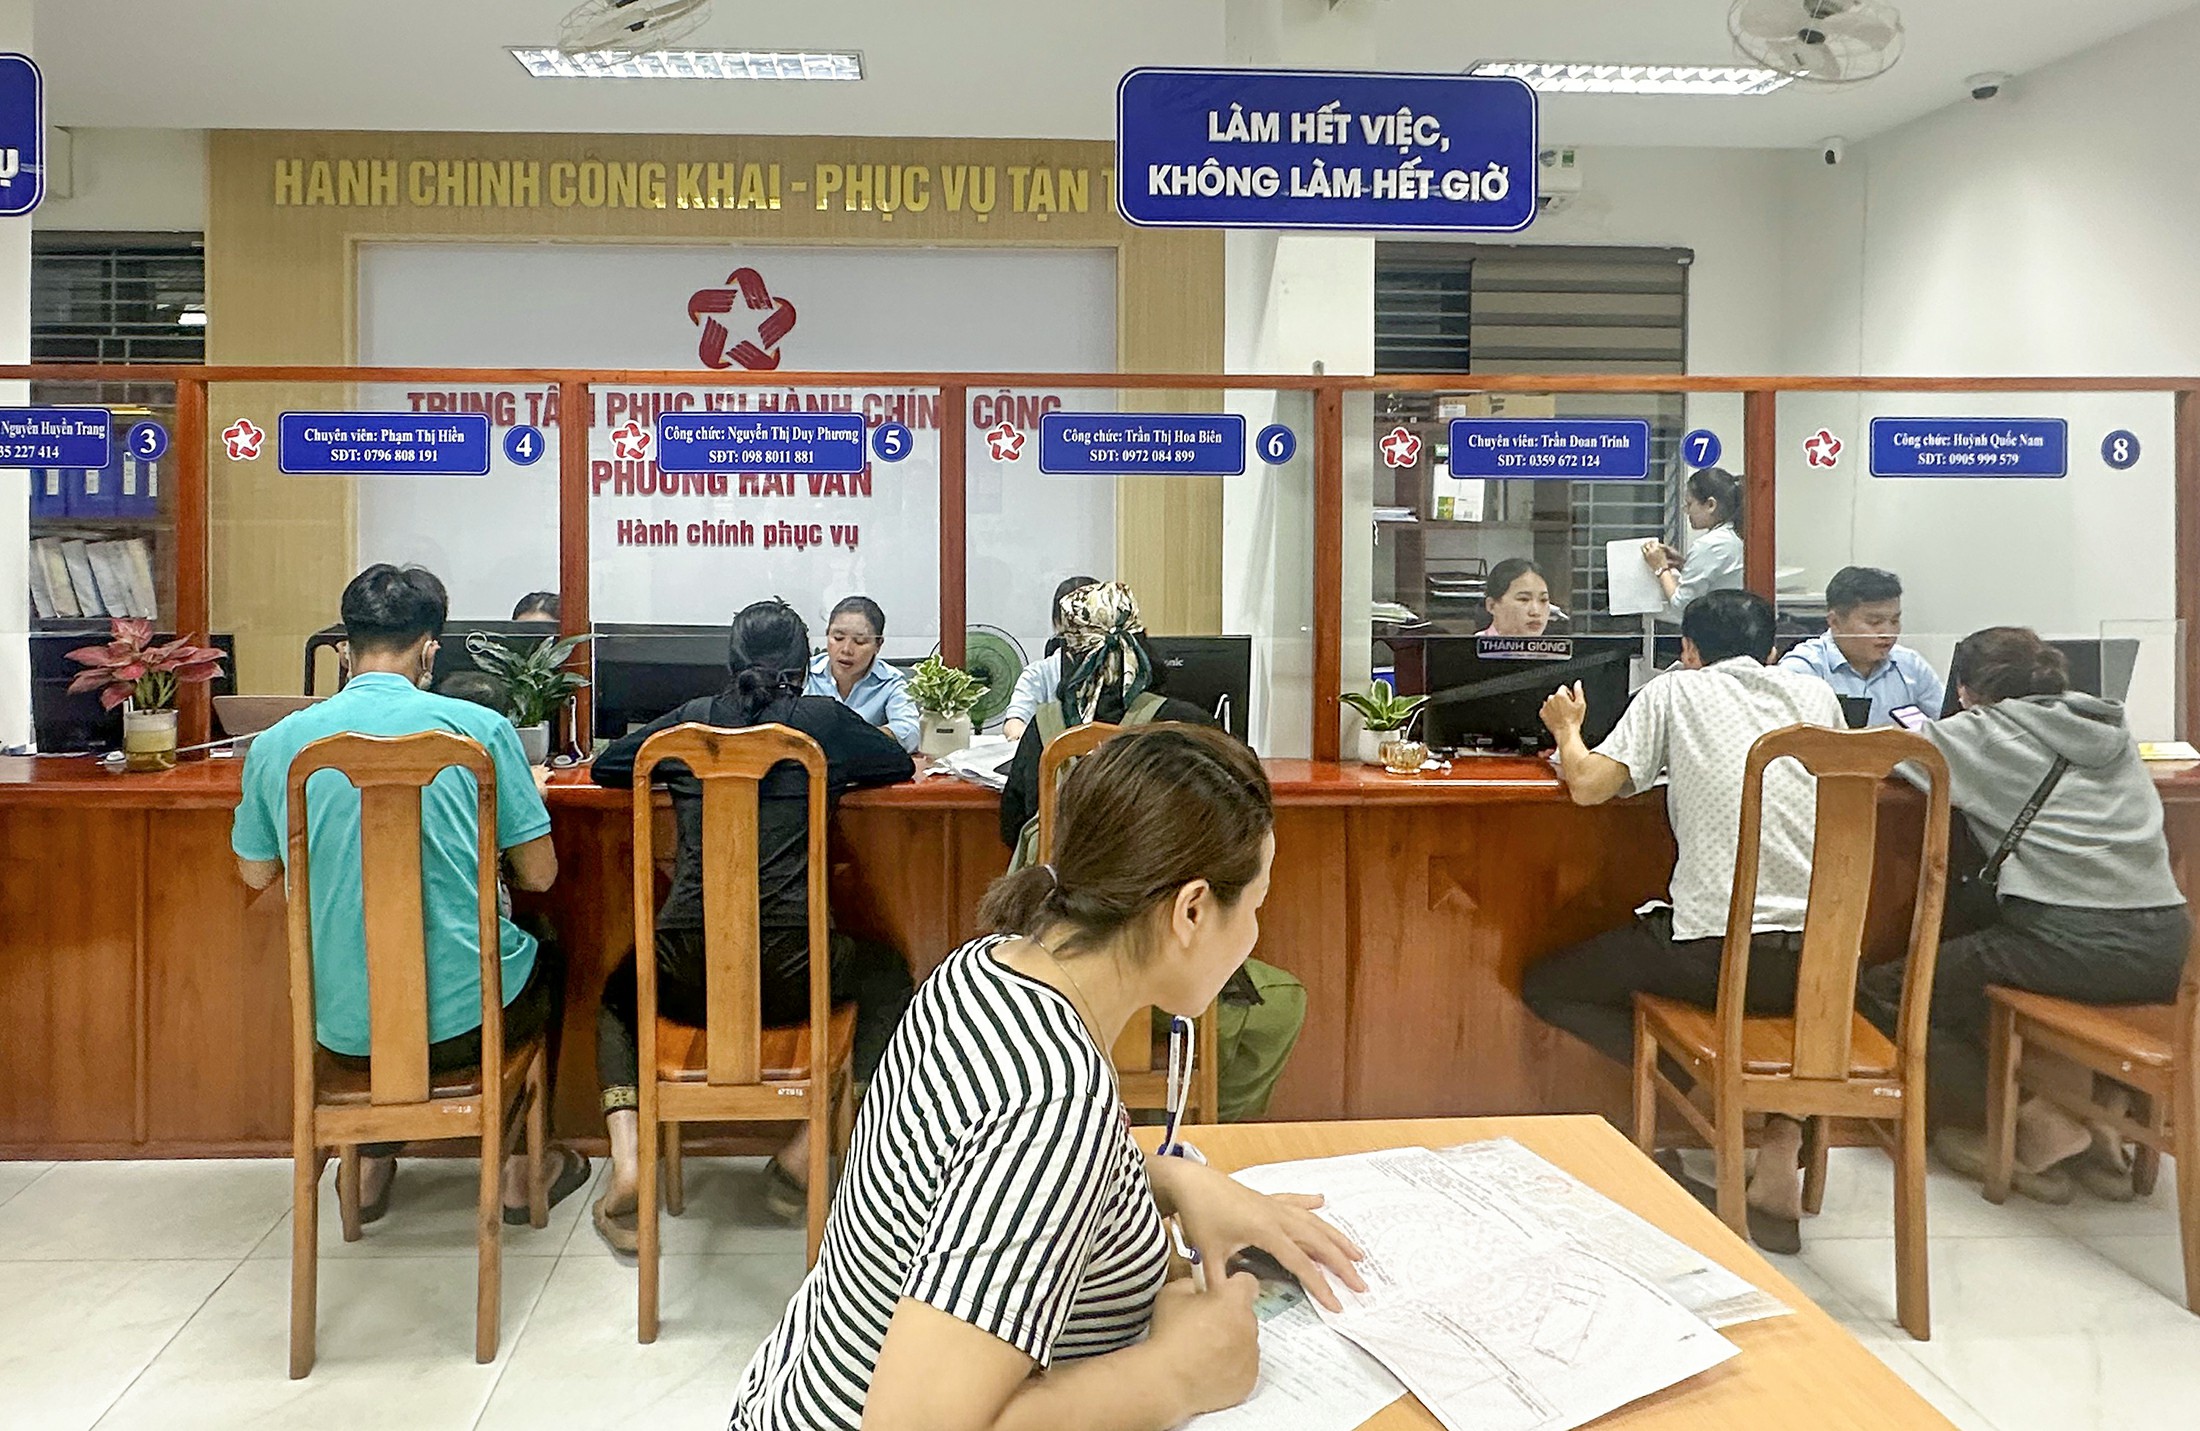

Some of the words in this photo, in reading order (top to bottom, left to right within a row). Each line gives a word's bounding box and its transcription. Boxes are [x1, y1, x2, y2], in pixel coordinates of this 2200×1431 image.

[1208, 102, 1280, 143] LÀM
[1290, 100, 1352, 145] HẾT
[1359, 106, 1450, 154] VIỆC,
[1148, 157, 1281, 198] KHÔNG
[1290, 158, 1362, 199] LÀM
[1372, 155, 1434, 200] HẾT
[1440, 161, 1509, 203] GIỜ
[677, 162, 782, 210] KHAI
[815, 163, 930, 222] PHỤC
[941, 164, 996, 222] VỤ
[525, 385, 595, 427] TÂ
[862, 387, 941, 429] CHÍN
[41, 418, 73, 438] Huyền
[75, 421, 106, 439] Trang
[304, 428, 348, 444] Chuyên
[350, 428, 378, 442] viên:
[380, 428, 413, 445] Phạm
[415, 429, 436, 446] Thị
[438, 426, 465, 443] Hiền
[664, 425, 694, 444] Công
[695, 425, 725, 441] chức:
[727, 422, 769, 444] Nguyễn
[770, 426, 790, 444] Thị
[792, 426, 815, 445] Duy
[817, 426, 860, 445] Phương
[1062, 428, 1092, 445] Công
[1093, 428, 1123, 443] chức:
[1124, 425, 1151, 443] Trần
[1152, 429, 1172, 446] Thị
[1174, 429, 1196, 443] Hoa
[1198, 429, 1222, 443] Biên
[1893, 432, 1921, 449] Công
[1922, 432, 1951, 448] chức:
[1989, 429, 2018, 448] Quốc
[2019, 433, 2044, 447] Nam
[14, 446, 35, 458] 227
[38, 446, 60, 458] 414
[140, 428, 157, 454] 3
[515, 432, 533, 458] 4
[884, 429, 901, 454] 5
[1267, 432, 1285, 457] 6
[1468, 433, 1510, 450] Chuyên
[1512, 433, 1539, 448] viên:
[1540, 431, 1567, 448] Trần
[1569, 434, 1598, 448] Đoan
[1693, 437, 1710, 462] 7
[2112, 437, 2129, 462] 8
[363, 449, 392, 462] 0796
[394, 449, 416, 462] 808
[418, 449, 438, 462] 191
[708, 450, 739, 463] SĐT:
[741, 450, 763, 463] 098
[764, 450, 791, 463] 8011
[793, 450, 814, 463] 881
[1122, 449, 1149, 462] 0972
[1151, 449, 1172, 462] 084
[1174, 450, 1195, 462] 899
[1529, 454, 1556, 467] 0359
[1557, 454, 1578, 467] 672
[1581, 454, 1600, 467] 124
[1948, 453, 1975, 466] 0905
[1976, 453, 1998, 466] 999
[1999, 453, 2020, 466] 579
[617, 518, 679, 547] Hành
[686, 518, 754, 547] chính
[763, 519, 823, 552] phục
[830, 524, 860, 552] vụ
